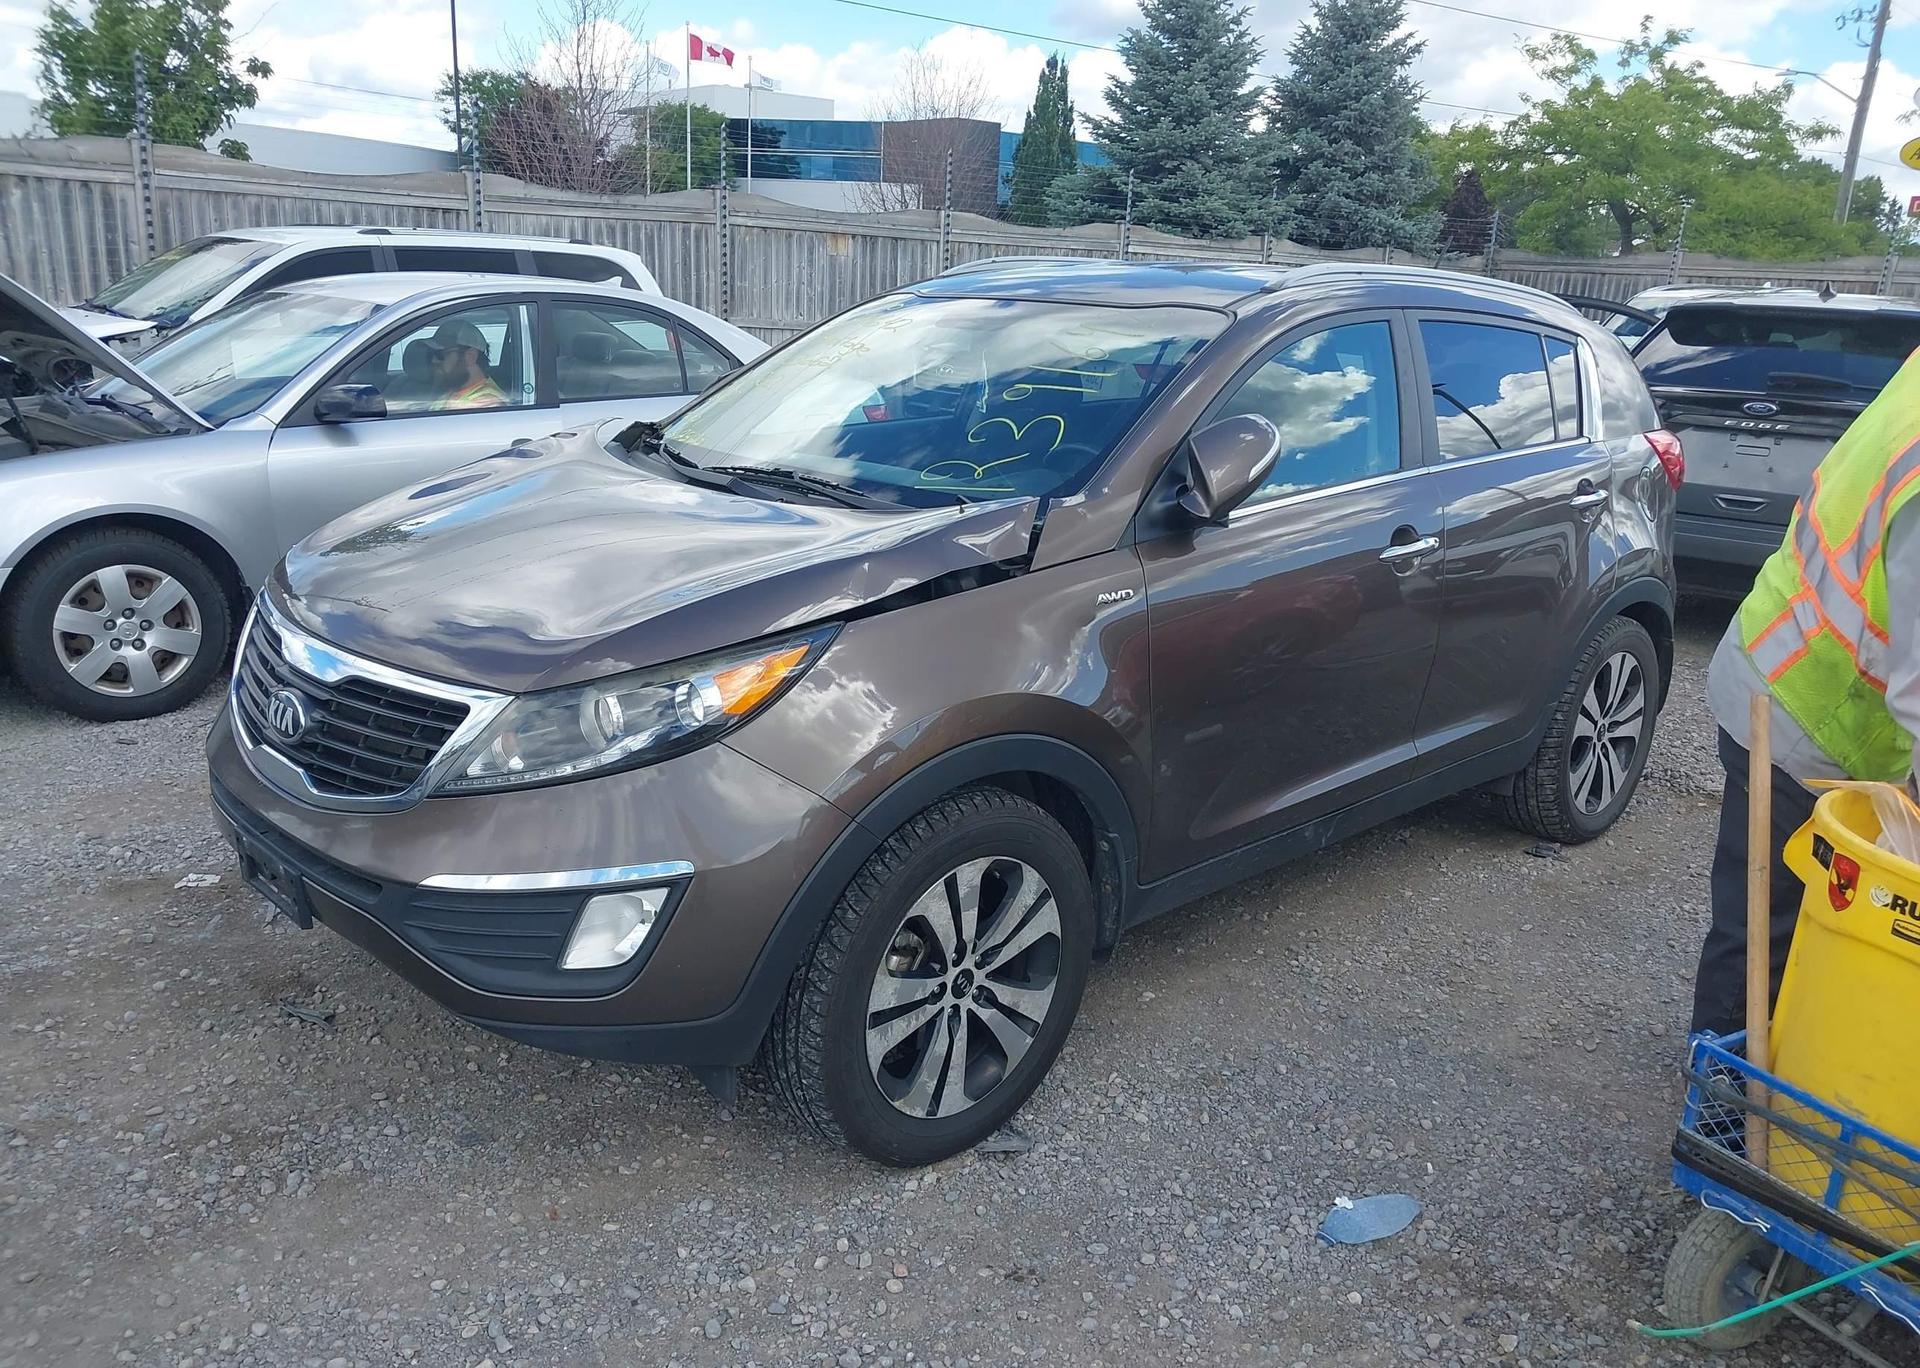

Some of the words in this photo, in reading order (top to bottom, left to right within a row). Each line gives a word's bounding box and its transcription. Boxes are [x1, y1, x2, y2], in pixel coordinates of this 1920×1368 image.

[1724, 420, 1790, 430] EDGE
[1096, 588, 1135, 606] AWD
[269, 696, 294, 736] KIA
